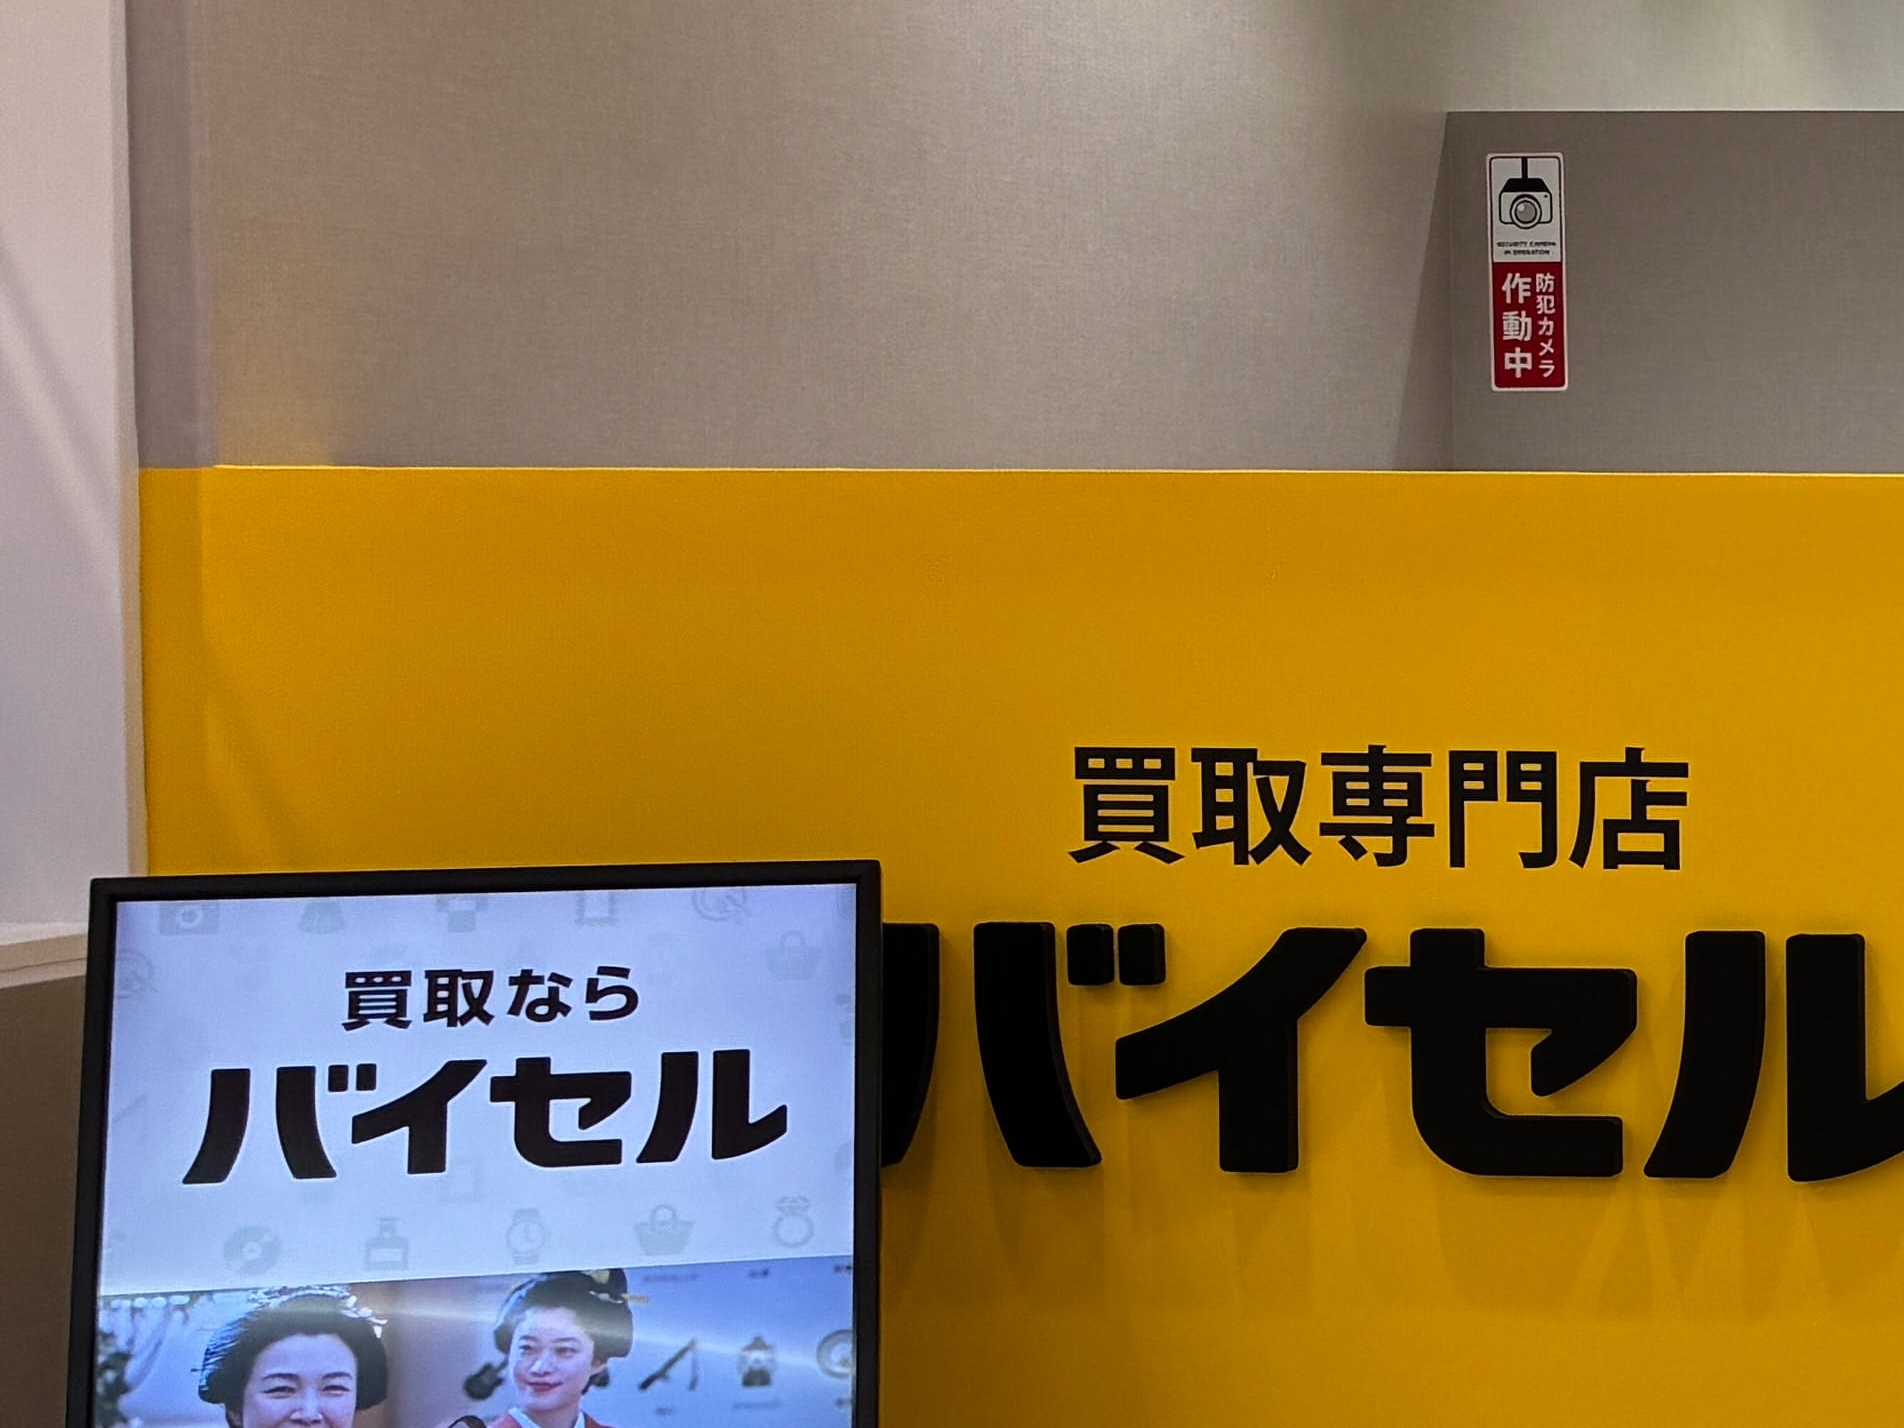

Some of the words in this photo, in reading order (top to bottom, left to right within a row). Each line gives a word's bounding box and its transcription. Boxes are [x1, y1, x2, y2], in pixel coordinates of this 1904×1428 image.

[1501, 272, 1533, 379] 作動中
[1535, 272, 1556, 378] 防犯カメラ
[1067, 745, 1690, 871] 買取専門店
[343, 965, 641, 1031] 買取なら
[182, 1048, 788, 1185] バイセル
